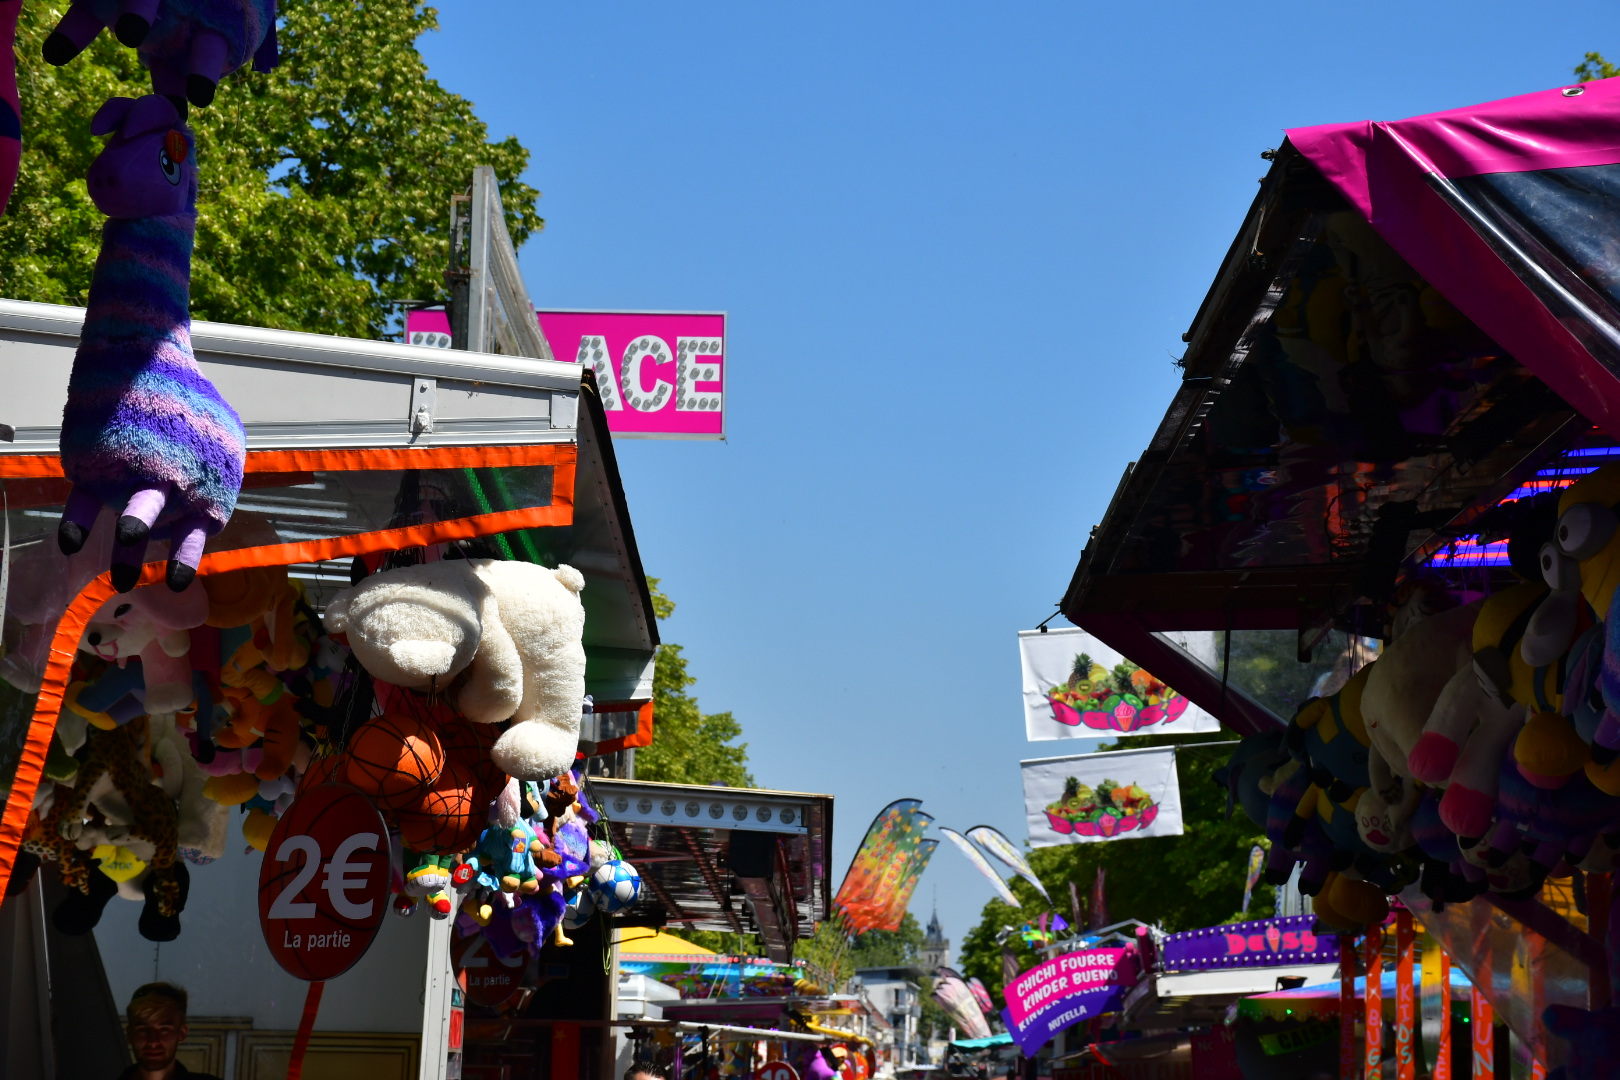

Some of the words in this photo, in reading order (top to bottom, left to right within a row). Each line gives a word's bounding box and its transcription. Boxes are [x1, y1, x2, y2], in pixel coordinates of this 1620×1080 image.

[267, 832, 381, 921] 2€
[283, 931, 302, 949] La
[306, 930, 352, 952] partie
[468, 975, 481, 987] La
[483, 974, 512, 989] partie
[1016, 963, 1057, 999] CHICHI
[1060, 953, 1116, 973] FOURRE
[1022, 976, 1069, 1013] KINDER
[1071, 968, 1119, 986] BUENO
[1047, 1004, 1088, 1033] NUTELLA
